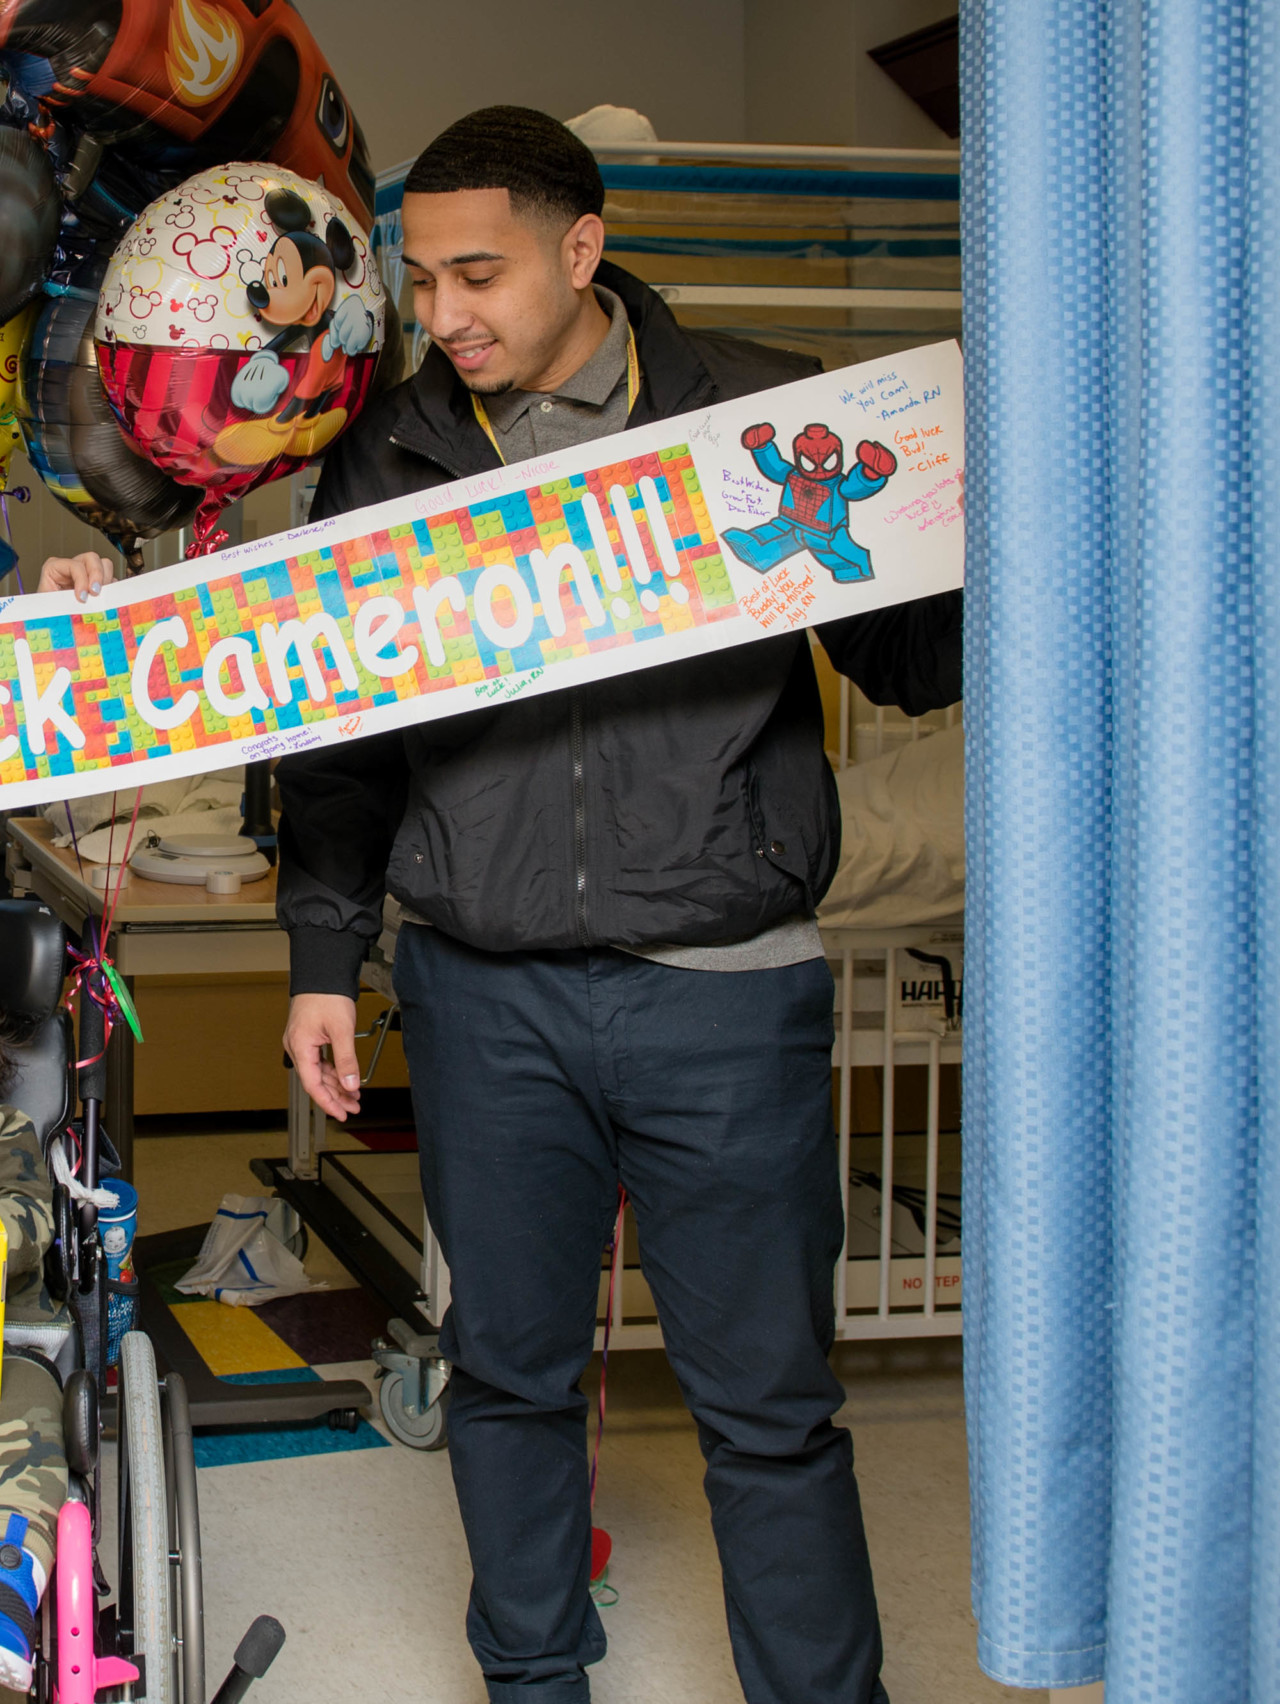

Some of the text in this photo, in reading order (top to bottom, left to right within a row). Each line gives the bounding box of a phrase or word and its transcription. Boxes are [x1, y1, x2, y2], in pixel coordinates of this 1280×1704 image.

[839, 371, 898, 404] We will miss
[923, 385, 940, 404] RN
[894, 427, 917, 444] Good
[131, 475, 690, 730] Cameron!!!
[903, 1275, 960, 1290] NO TEP
